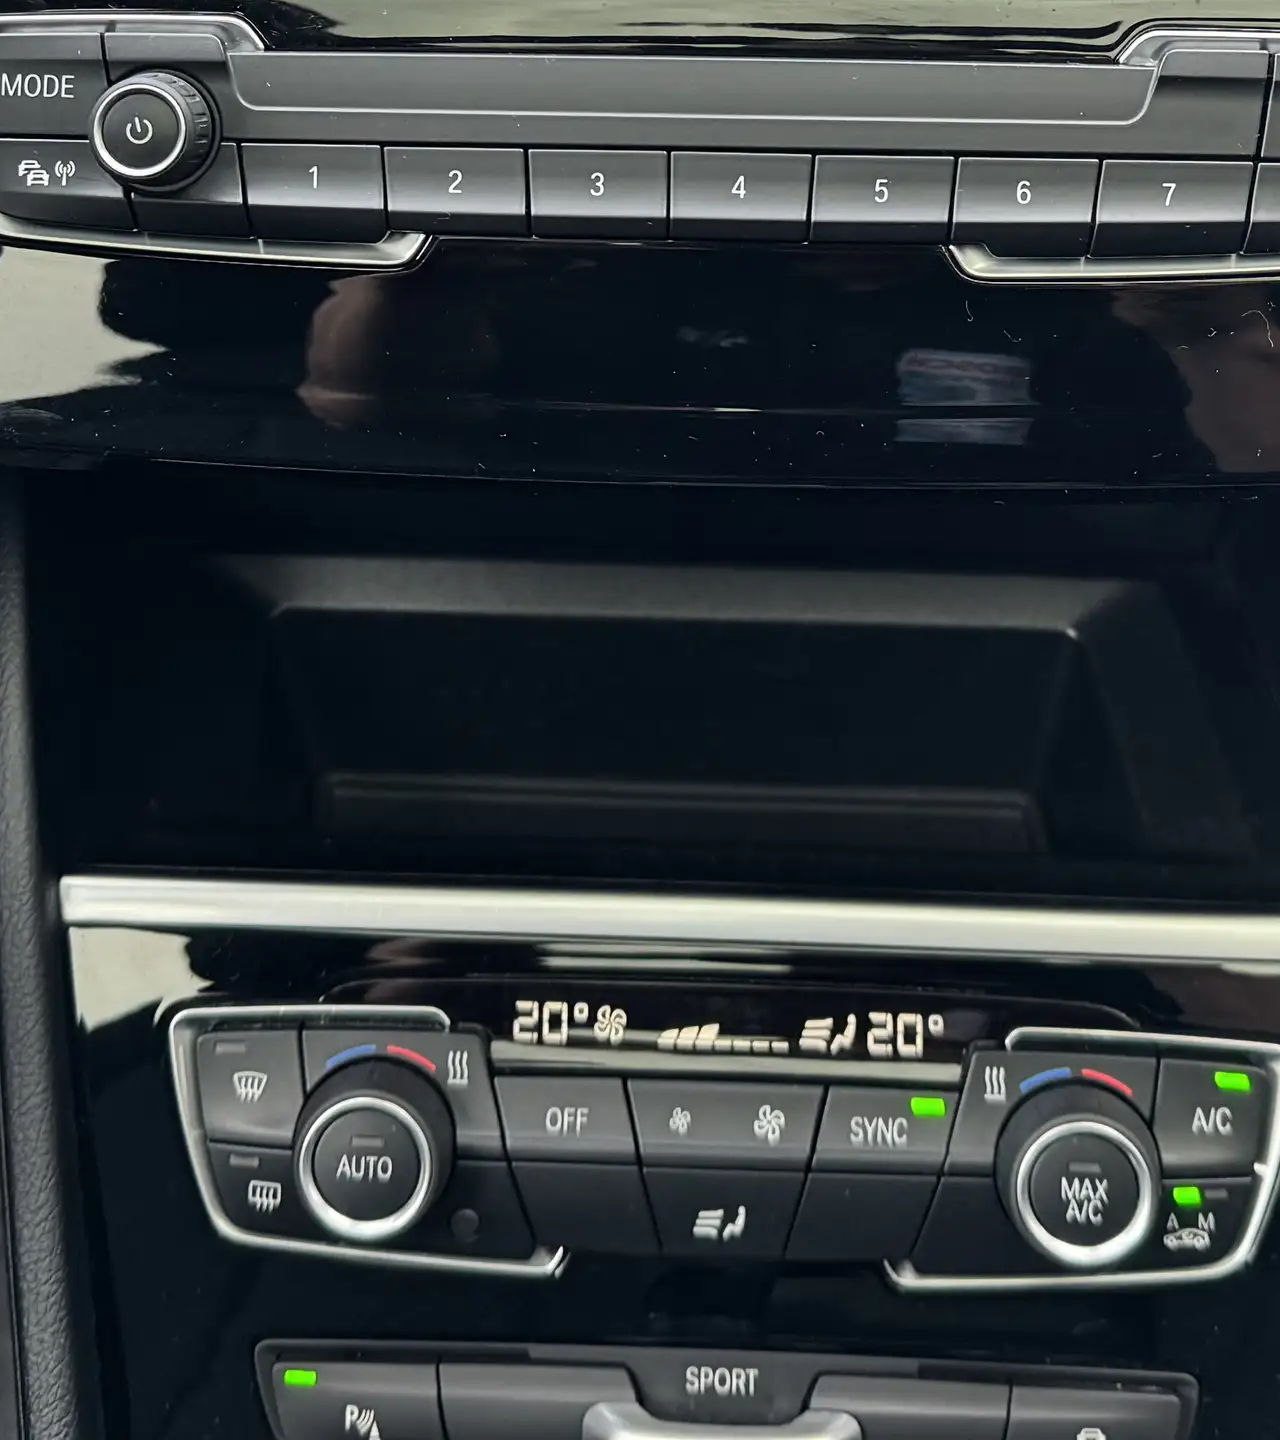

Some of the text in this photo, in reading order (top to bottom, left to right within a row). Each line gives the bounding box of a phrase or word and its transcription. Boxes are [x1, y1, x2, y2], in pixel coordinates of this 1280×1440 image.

[0, 73, 75, 99] MODE
[308, 165, 319, 189] 1
[447, 170, 464, 194] 2
[589, 172, 606, 197] 3
[731, 176, 747, 199] 4
[874, 179, 890, 203] 5
[1016, 181, 1032, 205] 6
[1162, 183, 1177, 207] 7
[545, 1107, 589, 1137] OFF
[850, 1116, 908, 1149] SYNC
[1192, 1106, 1234, 1136] A/C
[335, 1153, 393, 1183] AUTO
[1060, 1176, 1109, 1203] MAX
[1065, 1199, 1104, 1225] A/C
[1197, 1212, 1216, 1233] M
[685, 1366, 759, 1398] SPORT
